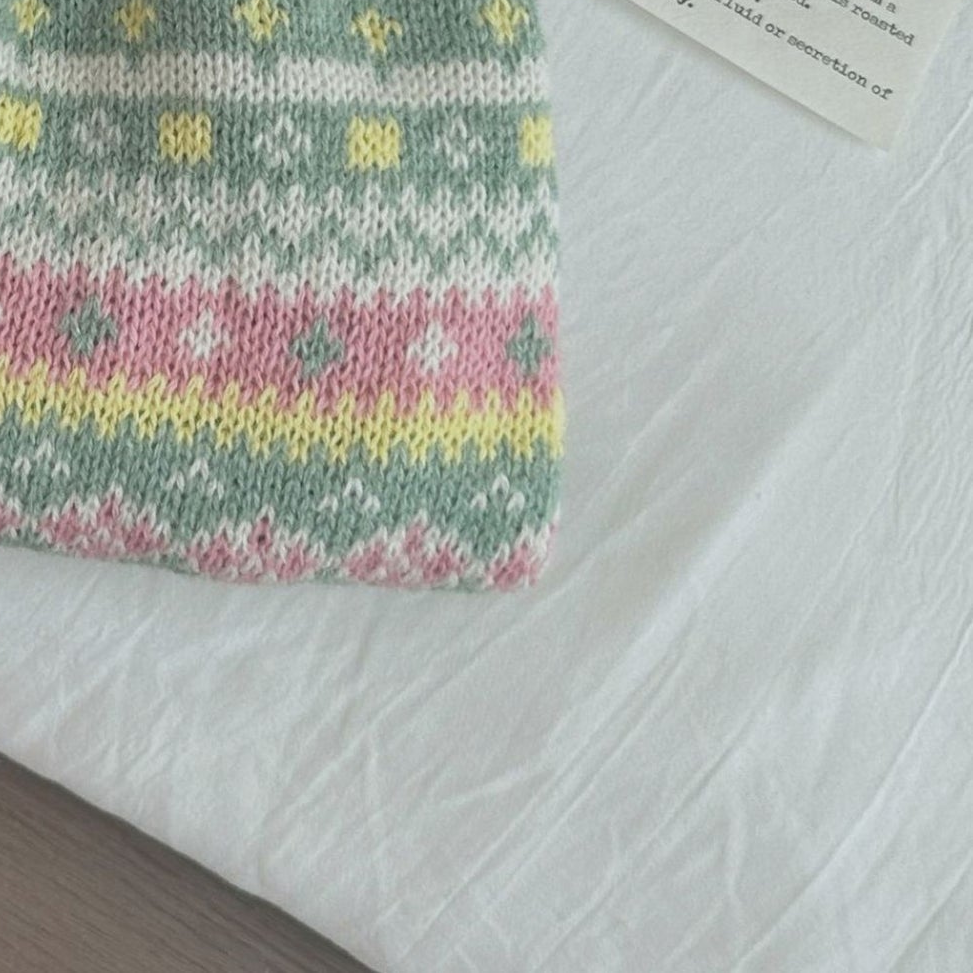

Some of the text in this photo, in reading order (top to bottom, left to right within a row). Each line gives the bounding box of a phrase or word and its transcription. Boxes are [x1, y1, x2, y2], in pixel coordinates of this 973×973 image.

[851, 4, 915, 46] roasted
[886, 3, 896, 13] a
[765, 23, 785, 38] or
[787, 35, 867, 87] secretion
[871, 85, 893, 99] of
